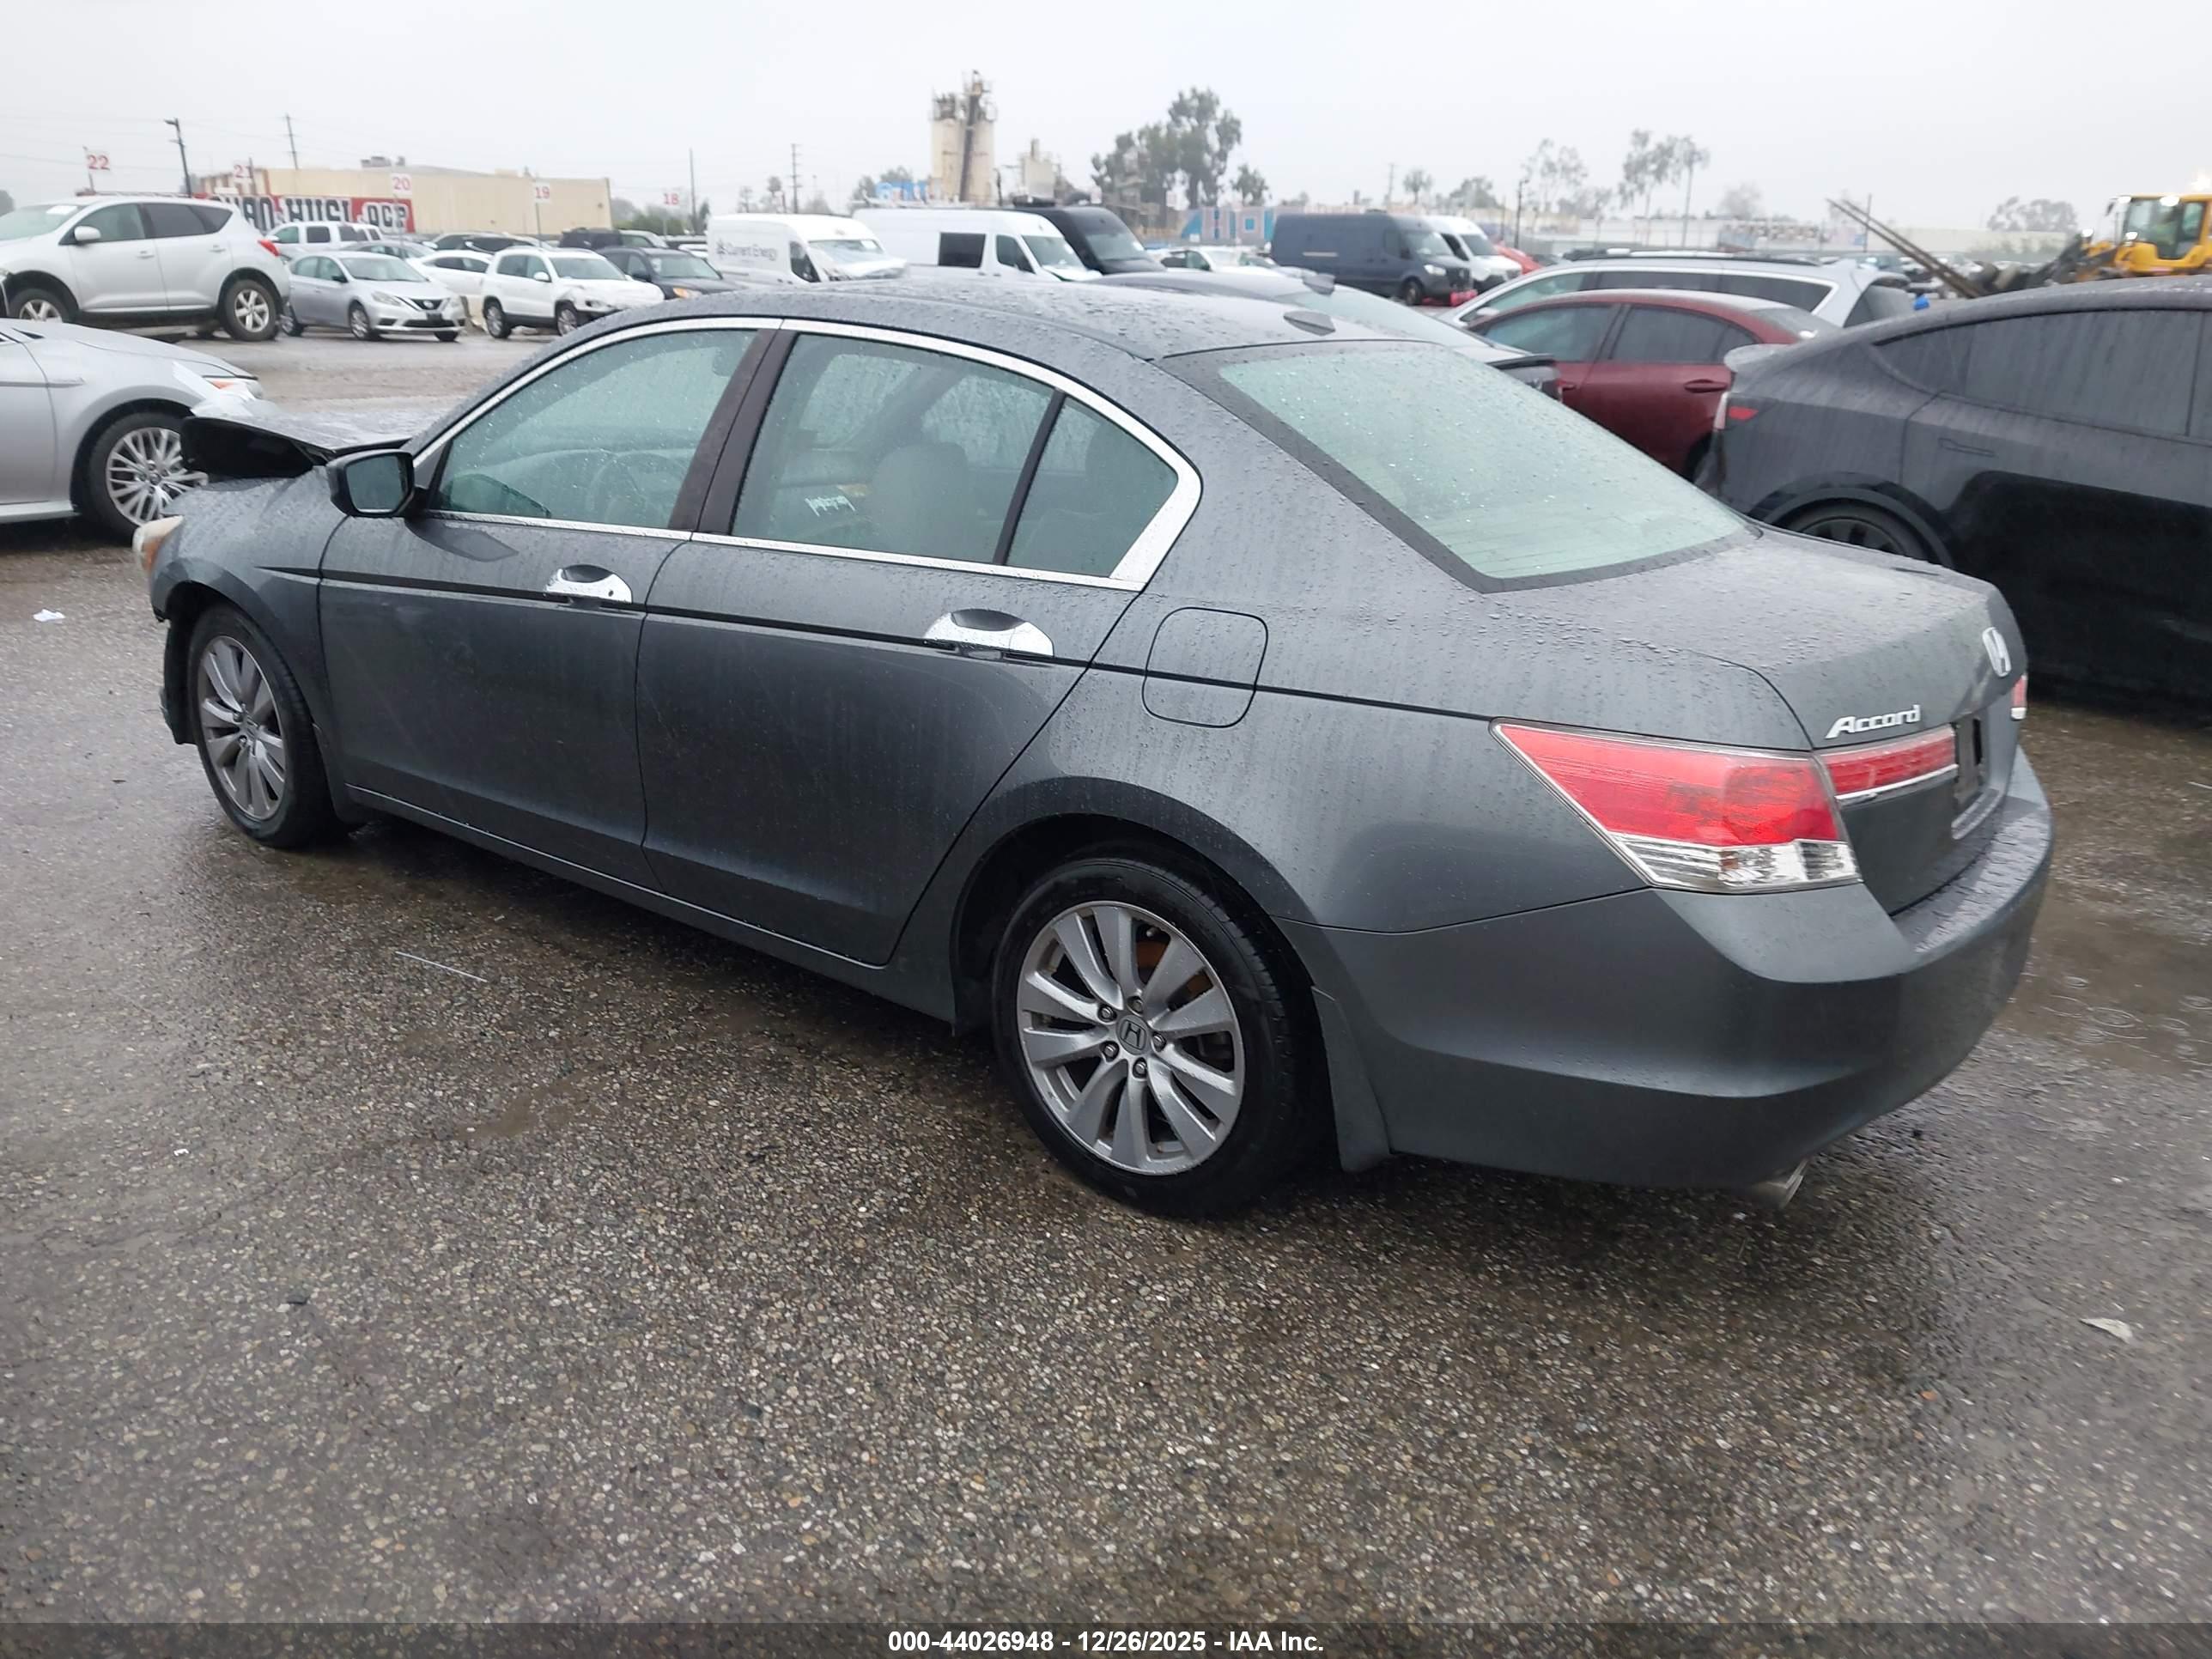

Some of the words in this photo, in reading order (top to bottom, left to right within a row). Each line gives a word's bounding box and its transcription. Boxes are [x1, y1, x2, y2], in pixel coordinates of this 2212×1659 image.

[87, 155, 110, 170] 22
[392, 176, 411, 191] 20
[535, 185, 550, 199] 19
[664, 193, 679, 205] 18
[1825, 704, 1921, 739] Accord
